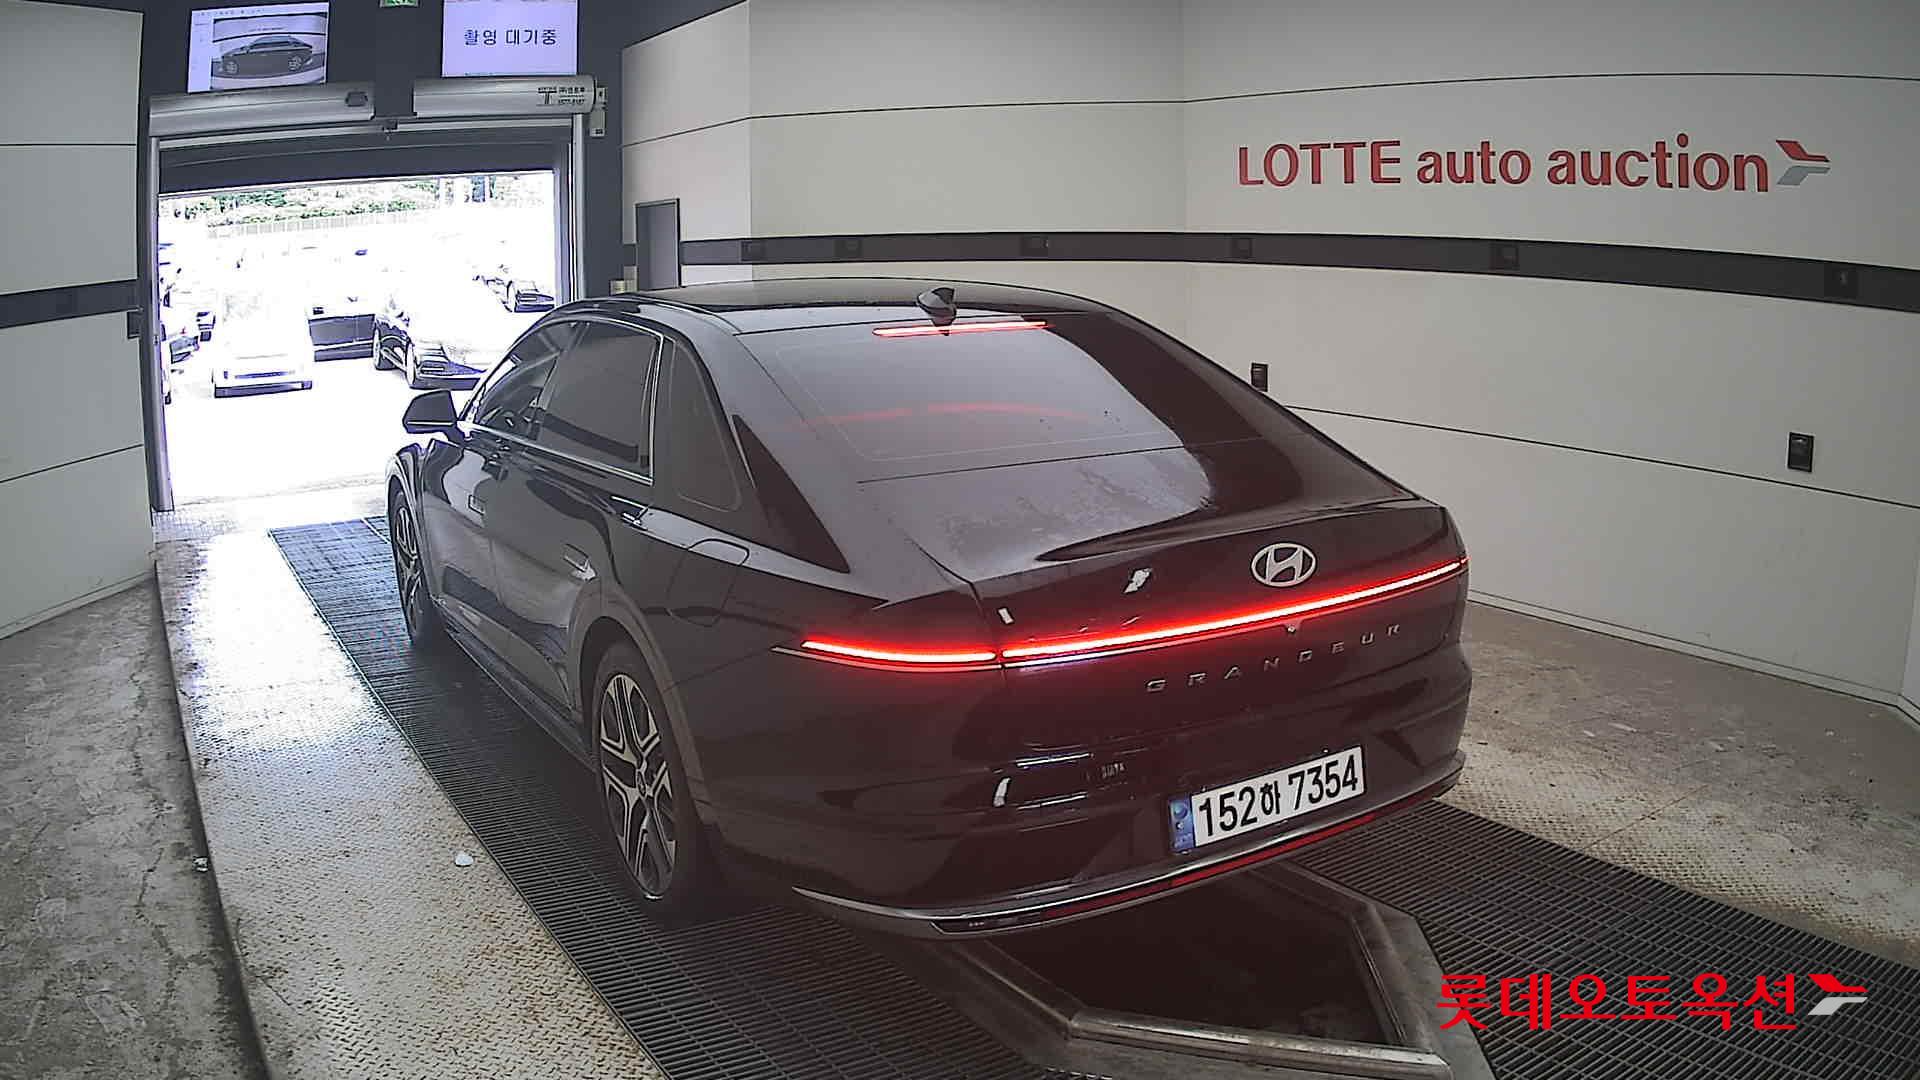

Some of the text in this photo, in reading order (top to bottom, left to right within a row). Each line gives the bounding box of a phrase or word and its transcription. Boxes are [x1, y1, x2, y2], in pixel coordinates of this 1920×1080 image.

[505, 29, 557, 46] 대기중
[1239, 132, 1769, 191] LOTTE auto auction
[1146, 624, 1402, 693] GRANDEUR
[1199, 754, 1359, 837] 152하 7354
